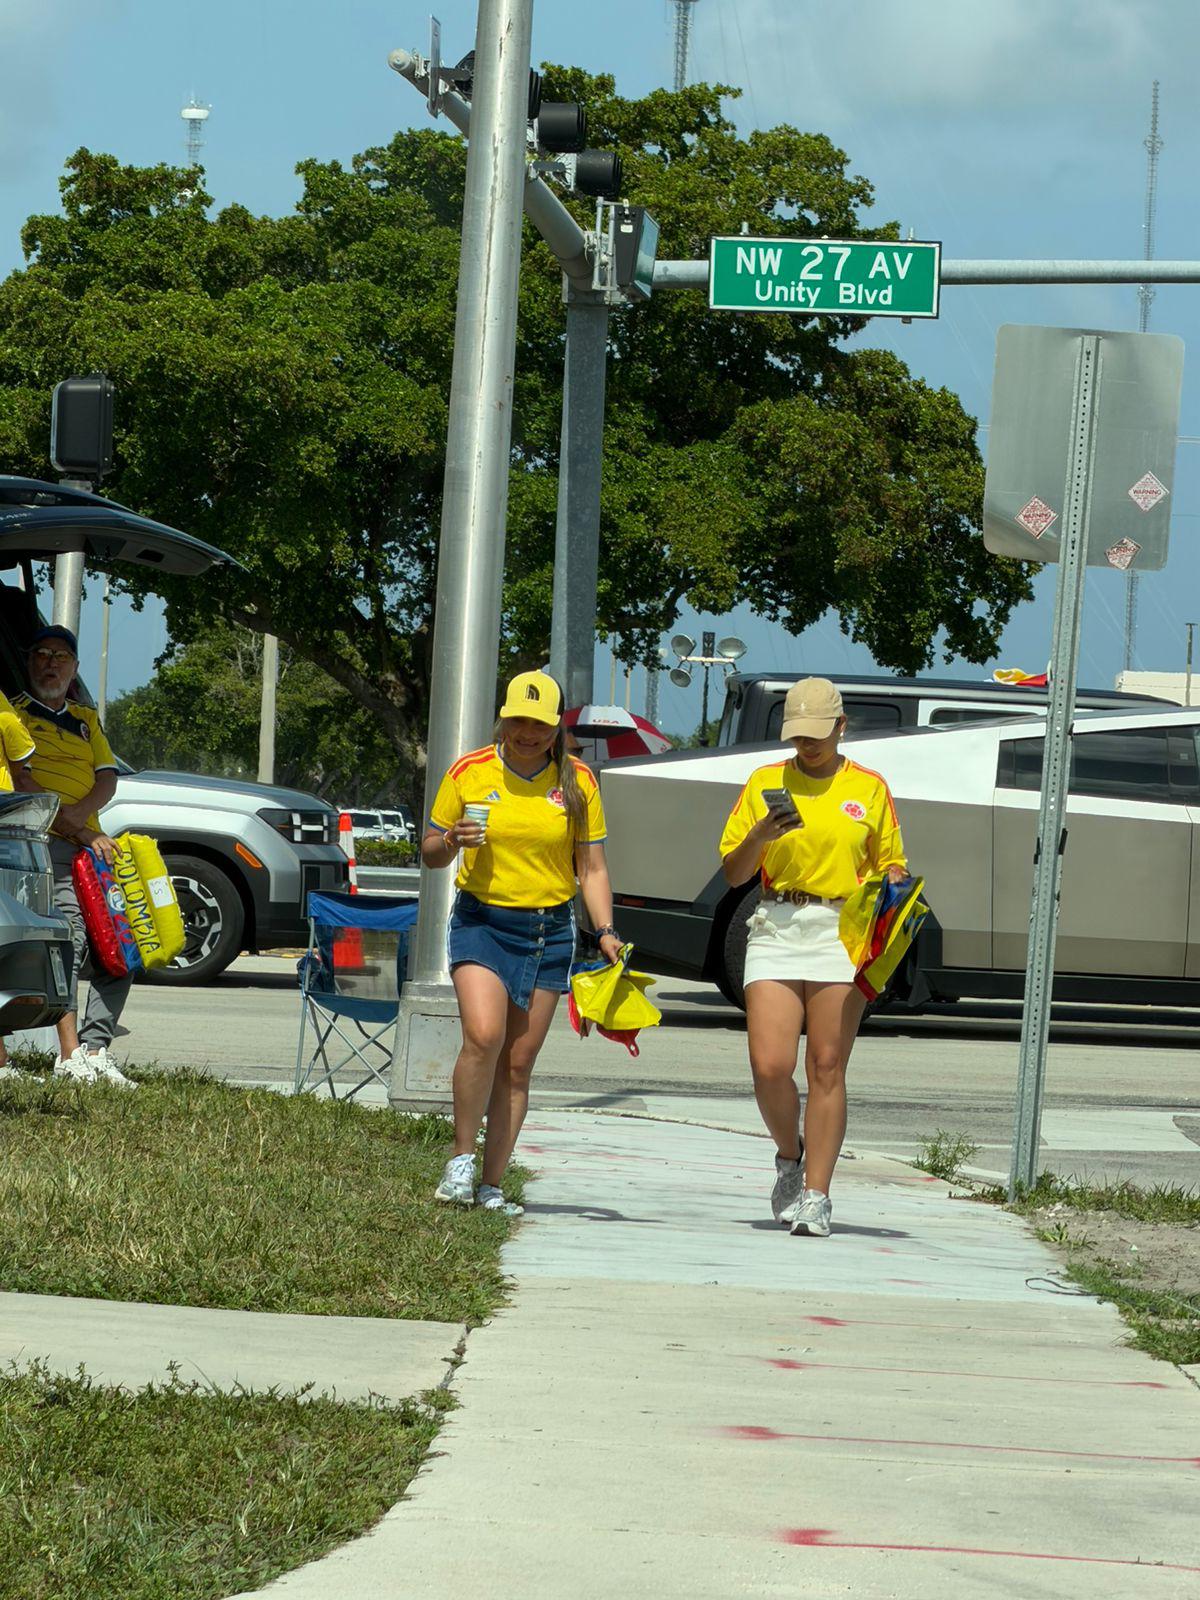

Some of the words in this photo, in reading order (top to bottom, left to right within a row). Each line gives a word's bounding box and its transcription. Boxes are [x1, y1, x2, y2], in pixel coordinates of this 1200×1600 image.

[736, 246, 783, 276] NW
[800, 245, 852, 281] 27
[868, 251, 913, 280] AV
[755, 280, 821, 307] Unity
[839, 282, 893, 305] Blvd
[1132, 488, 1162, 496] WARNING
[1107, 545, 1137, 556] WARNING
[114, 851, 161, 954] COLOMBIA
